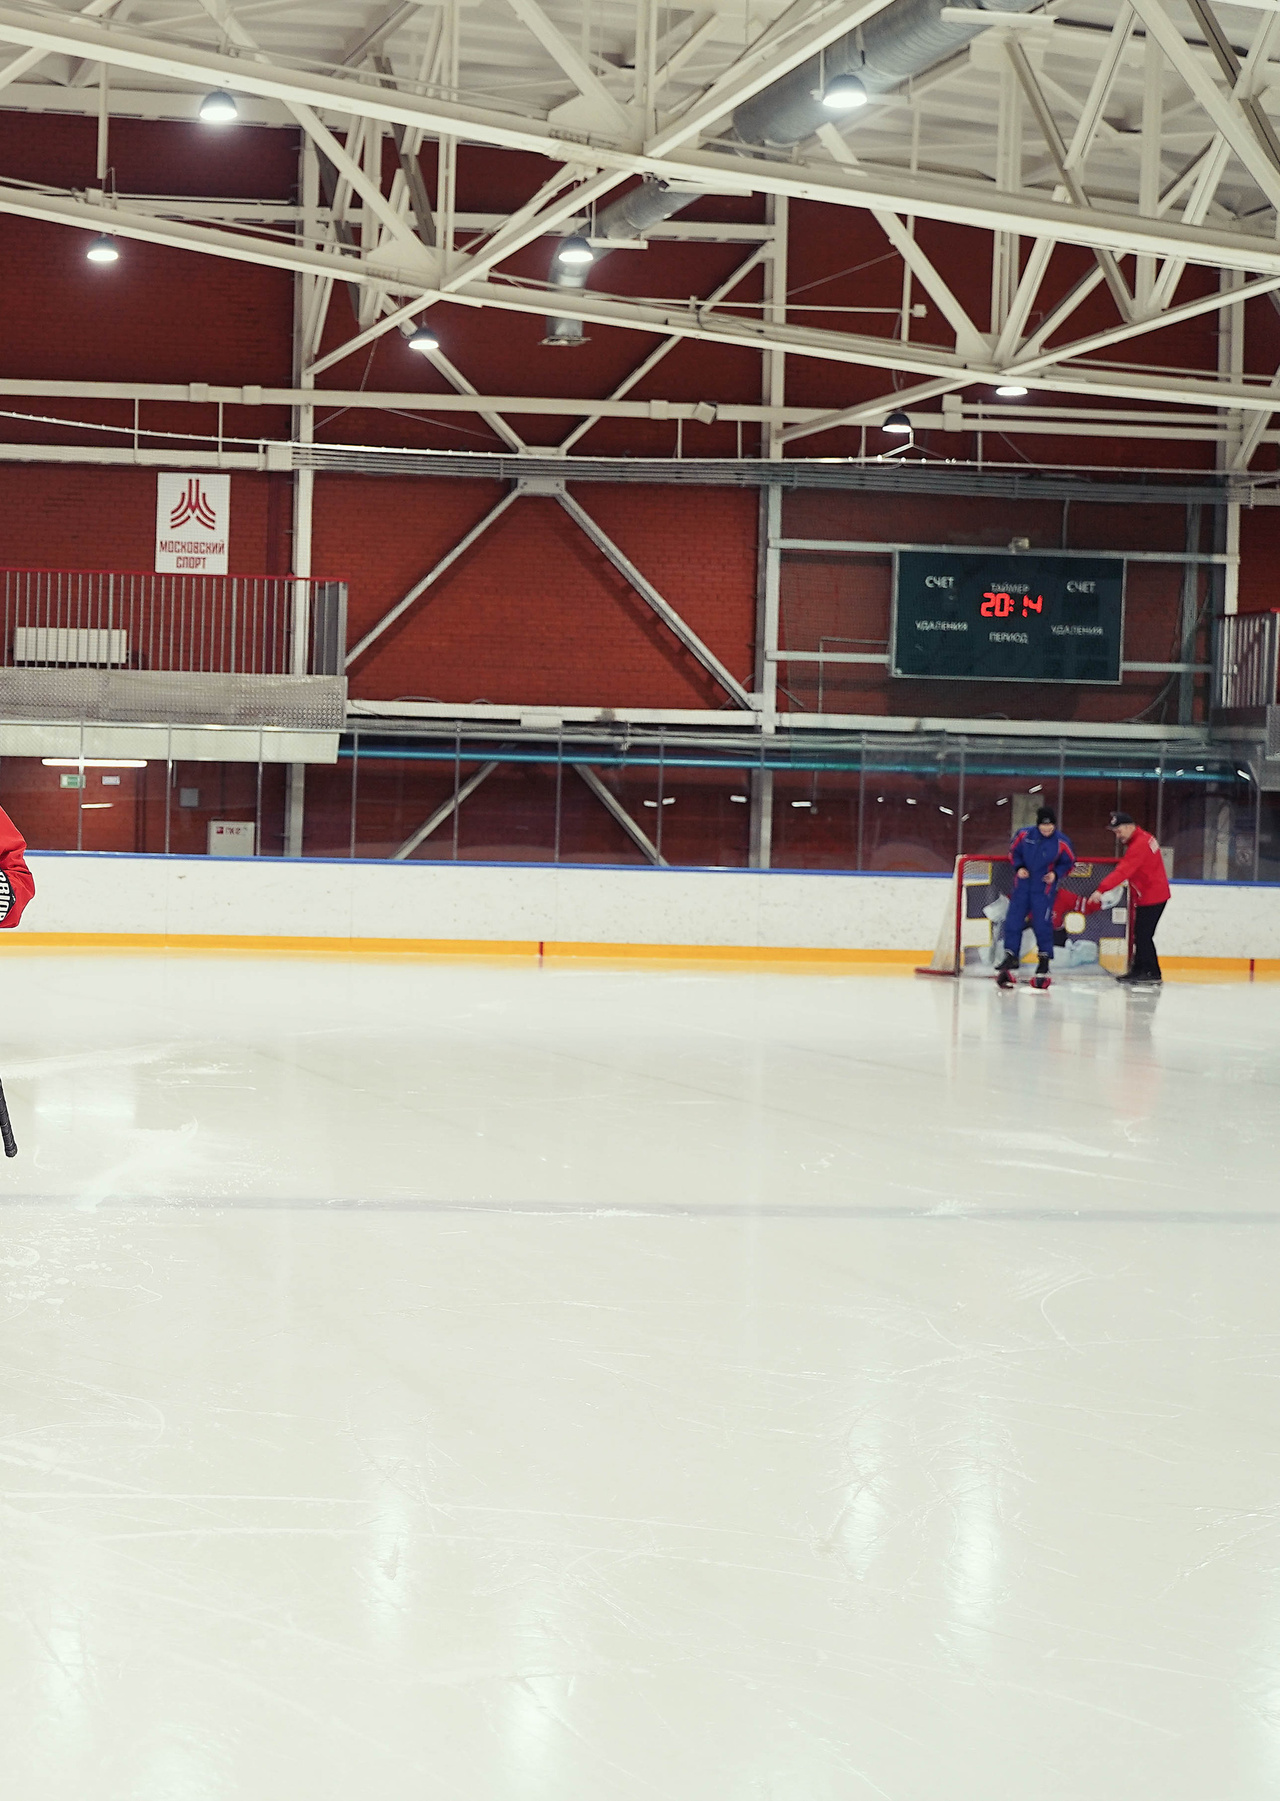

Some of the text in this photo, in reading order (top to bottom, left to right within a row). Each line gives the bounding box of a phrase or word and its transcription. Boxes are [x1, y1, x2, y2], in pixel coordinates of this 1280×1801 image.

[160, 540, 225, 554] МОСКОВСКИЙ
[176, 556, 207, 568] СПОРТ
[925, 576, 954, 589] СЧЕТ
[990, 581, 1030, 593] ТАЙМЕР
[1066, 581, 1096, 594] СЧЕТ
[980, 592, 1043, 618] 20:14
[915, 620, 969, 632] УДАЛЕНИЯ
[1051, 625, 1104, 637] УДАЛЕНИЯ
[989, 631, 1030, 645] ПЕРИОД
